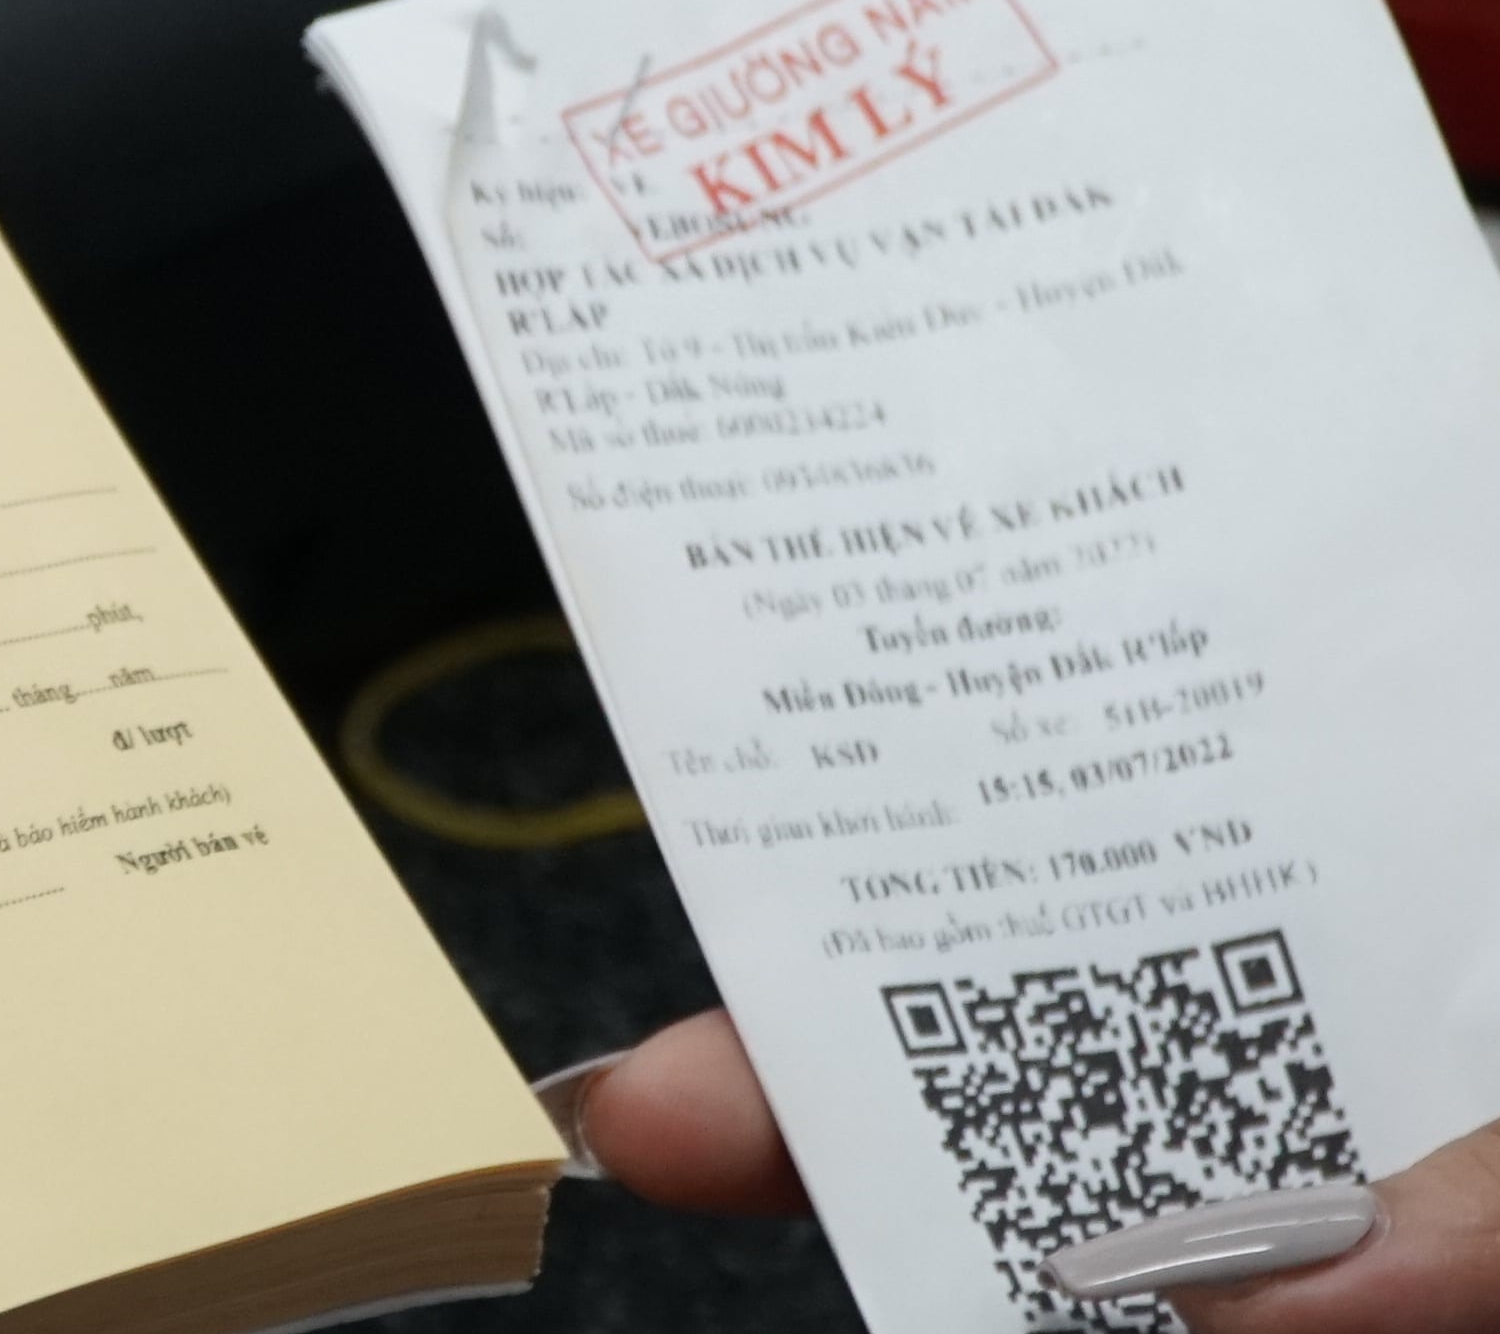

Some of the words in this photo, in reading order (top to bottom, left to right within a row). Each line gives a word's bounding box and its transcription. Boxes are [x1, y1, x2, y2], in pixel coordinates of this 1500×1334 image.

[692, 110, 848, 216] KIM
[850, 41, 951, 139] LÝ
[11, 683, 80, 709] tháng
[110, 796, 163, 823] hành
[164, 783, 232, 812] khách)
